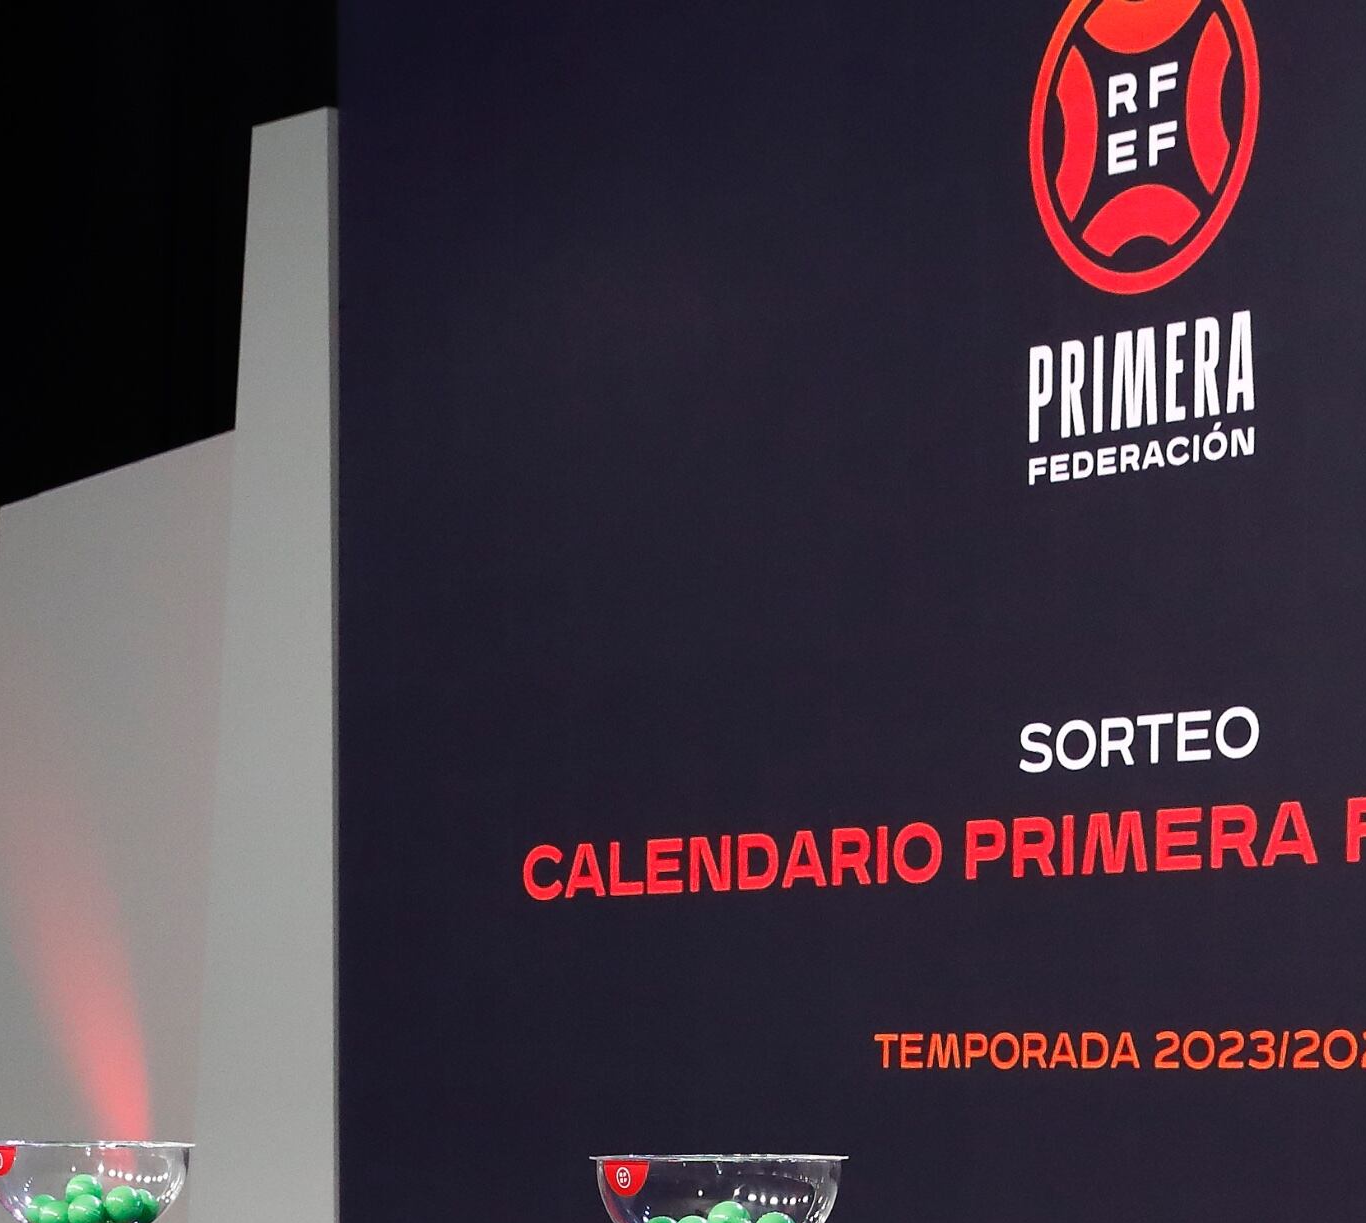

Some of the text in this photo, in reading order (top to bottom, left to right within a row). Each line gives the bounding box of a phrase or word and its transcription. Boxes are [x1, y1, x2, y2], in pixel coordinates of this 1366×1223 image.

[1108, 61, 1178, 117] RF
[1108, 121, 1178, 175] EF
[1029, 310, 1255, 443] PRIMERA
[1028, 422, 1255, 486] FEDERACIÓN
[1018, 706, 1260, 773] SORTEO
[522, 822, 942, 900] CALENDARIO
[965, 801, 1318, 880] PRIMERA
[873, 1031, 1140, 1070] TEMPORADA
